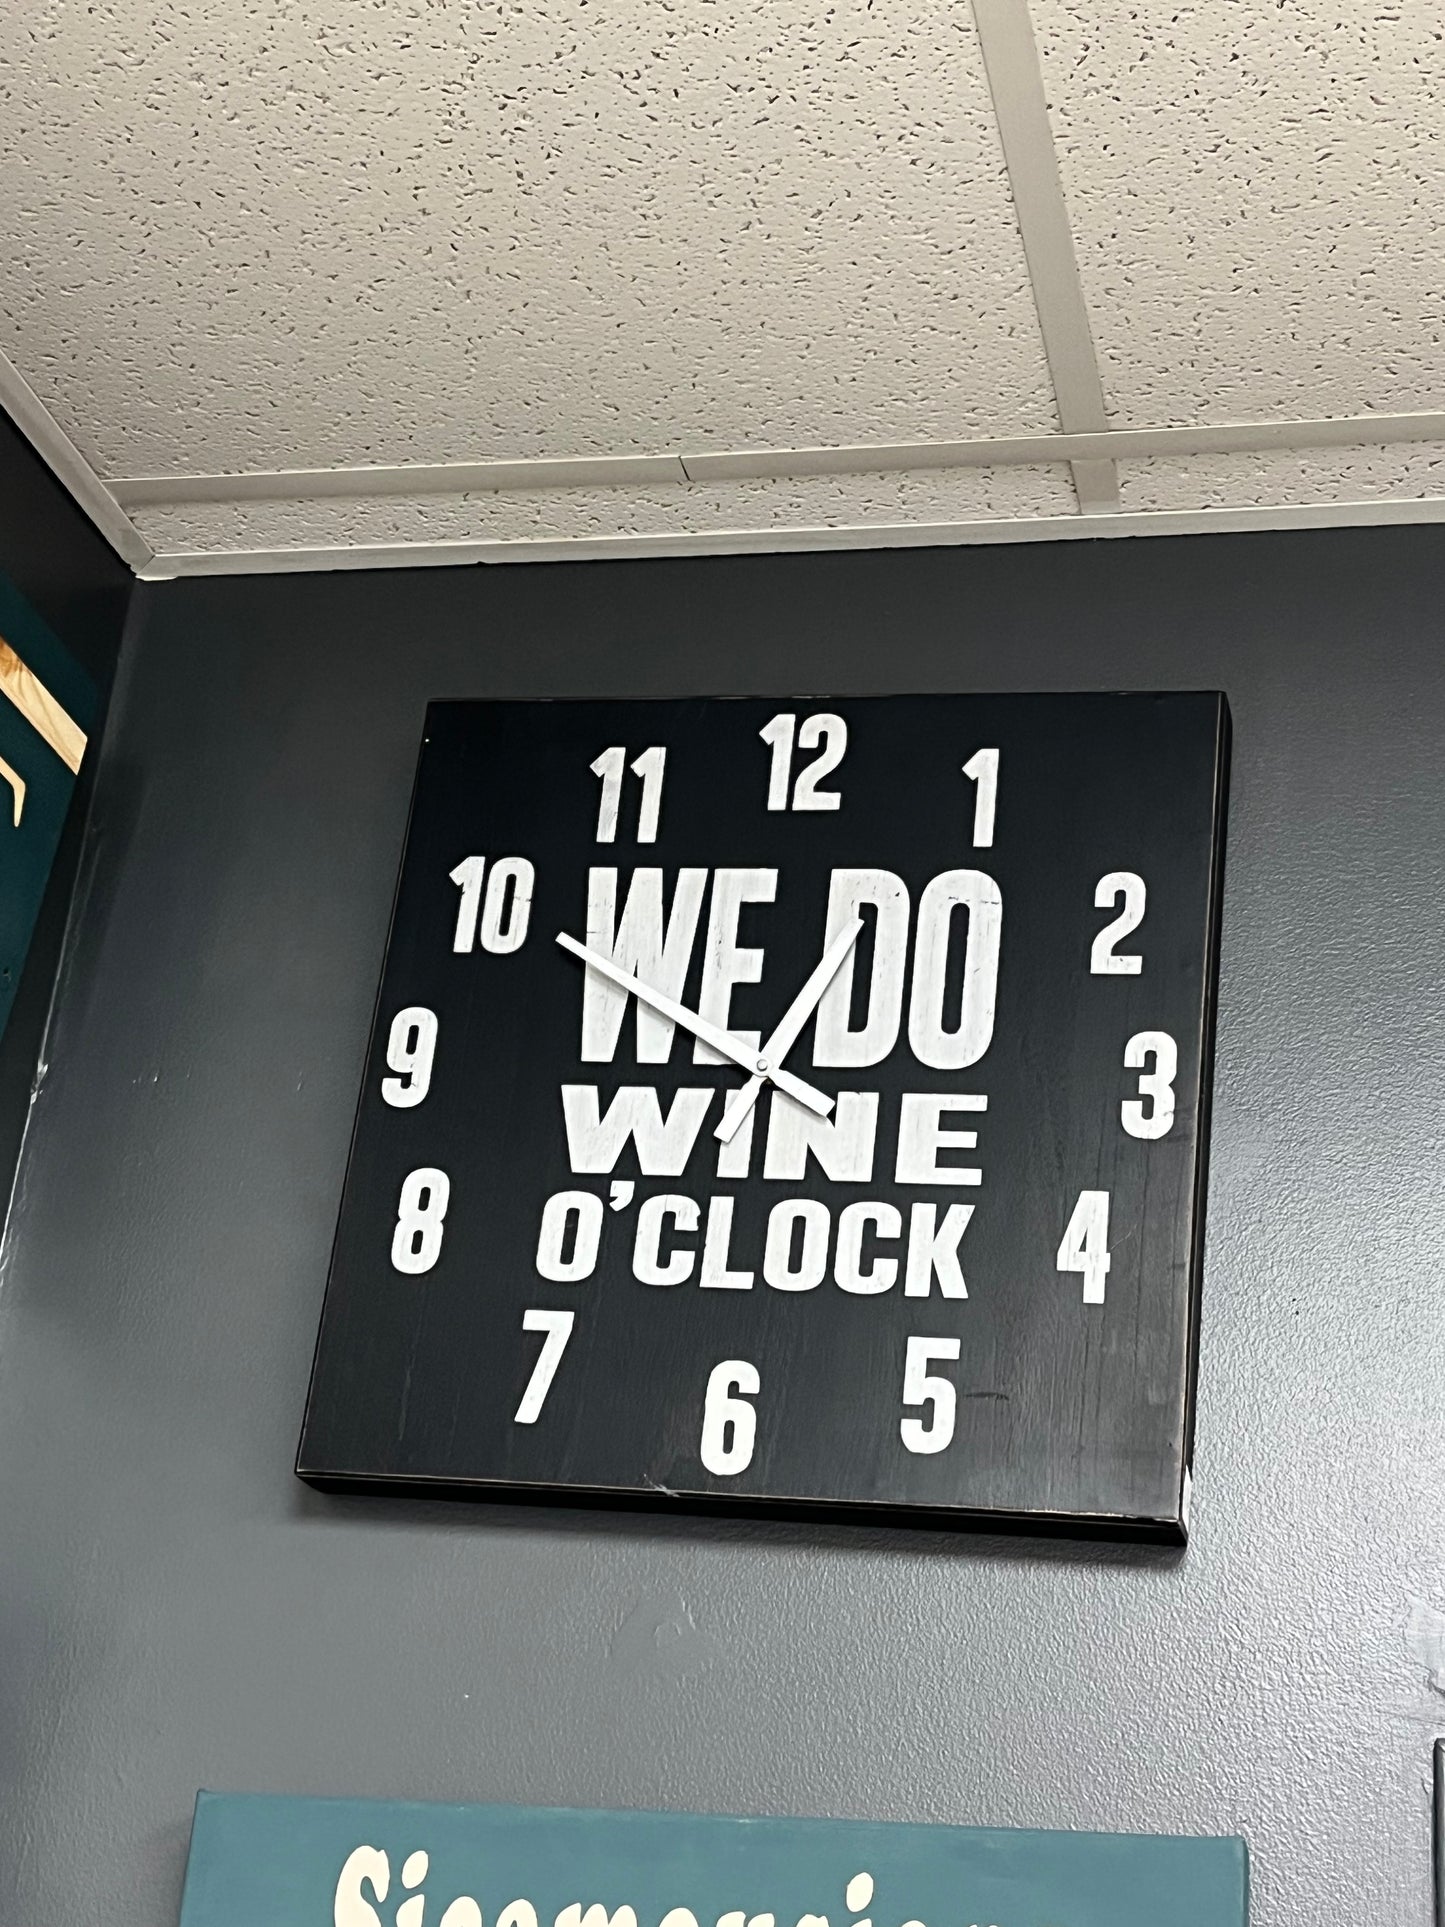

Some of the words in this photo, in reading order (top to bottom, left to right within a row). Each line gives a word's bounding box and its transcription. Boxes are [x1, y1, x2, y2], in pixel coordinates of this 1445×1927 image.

[590, 747, 667, 843] 11
[759, 714, 847, 810] 12
[962, 749, 999, 847] 1
[449, 856, 534, 953] 10
[1090, 872, 1146, 974] 2
[581, 867, 779, 1066] WE
[813, 868, 1003, 1070] DO
[382, 1007, 438, 1107] 9
[1121, 1031, 1177, 1139] 3
[561, 1085, 987, 1185] WINE
[391, 1168, 450, 1274] 8
[536, 1181, 975, 1298] O'CLOCK
[1057, 1191, 1110, 1304] 4
[515, 1310, 574, 1423] 7
[701, 1360, 760, 1475] 6
[901, 1336, 960, 1454] 5
